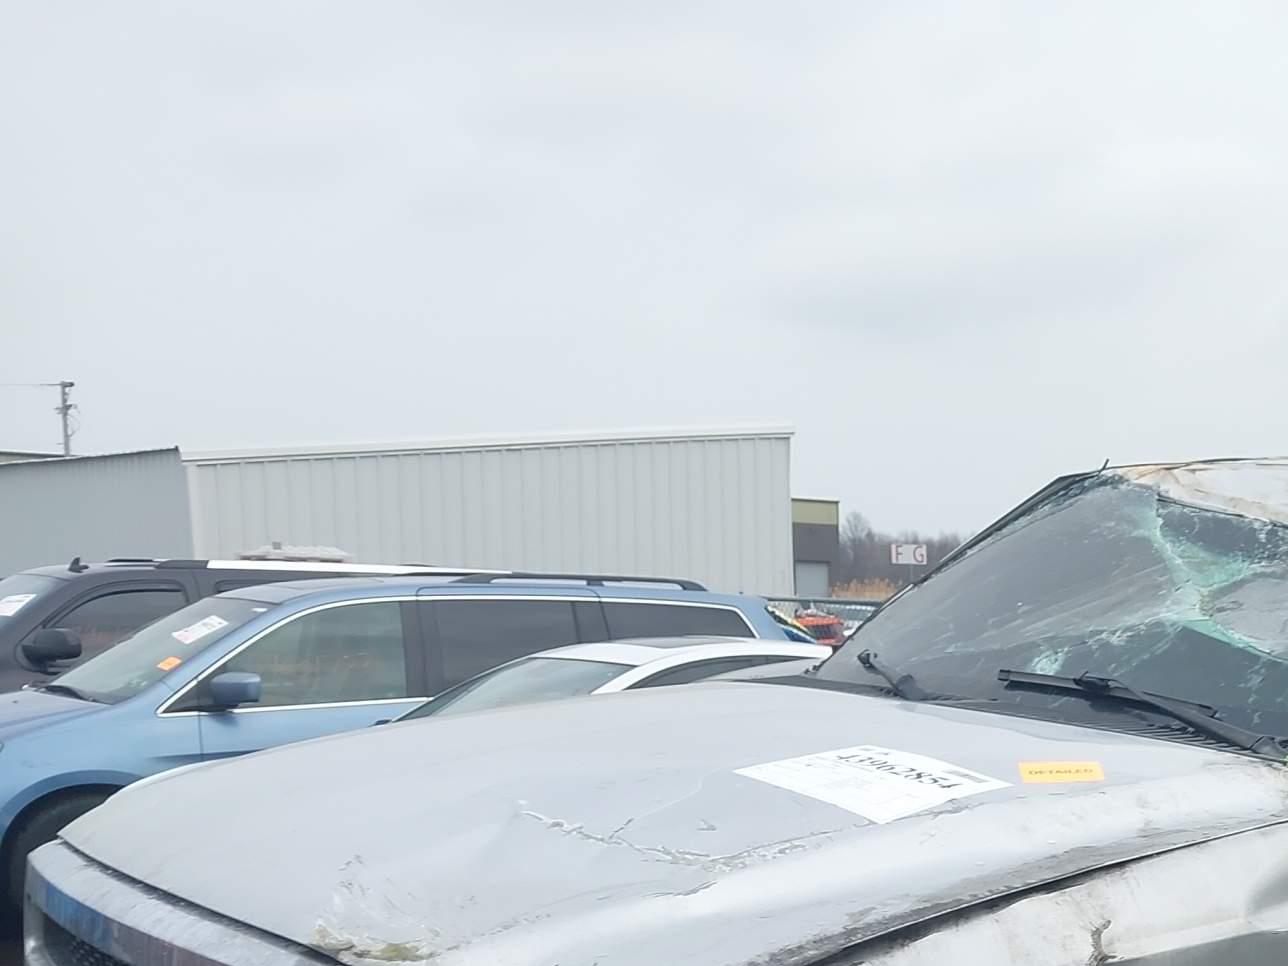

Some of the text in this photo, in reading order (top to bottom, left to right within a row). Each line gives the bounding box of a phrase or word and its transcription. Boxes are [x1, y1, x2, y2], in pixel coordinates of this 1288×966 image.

[895, 545, 925, 564] F G
[835, 752, 964, 789] 43962854
